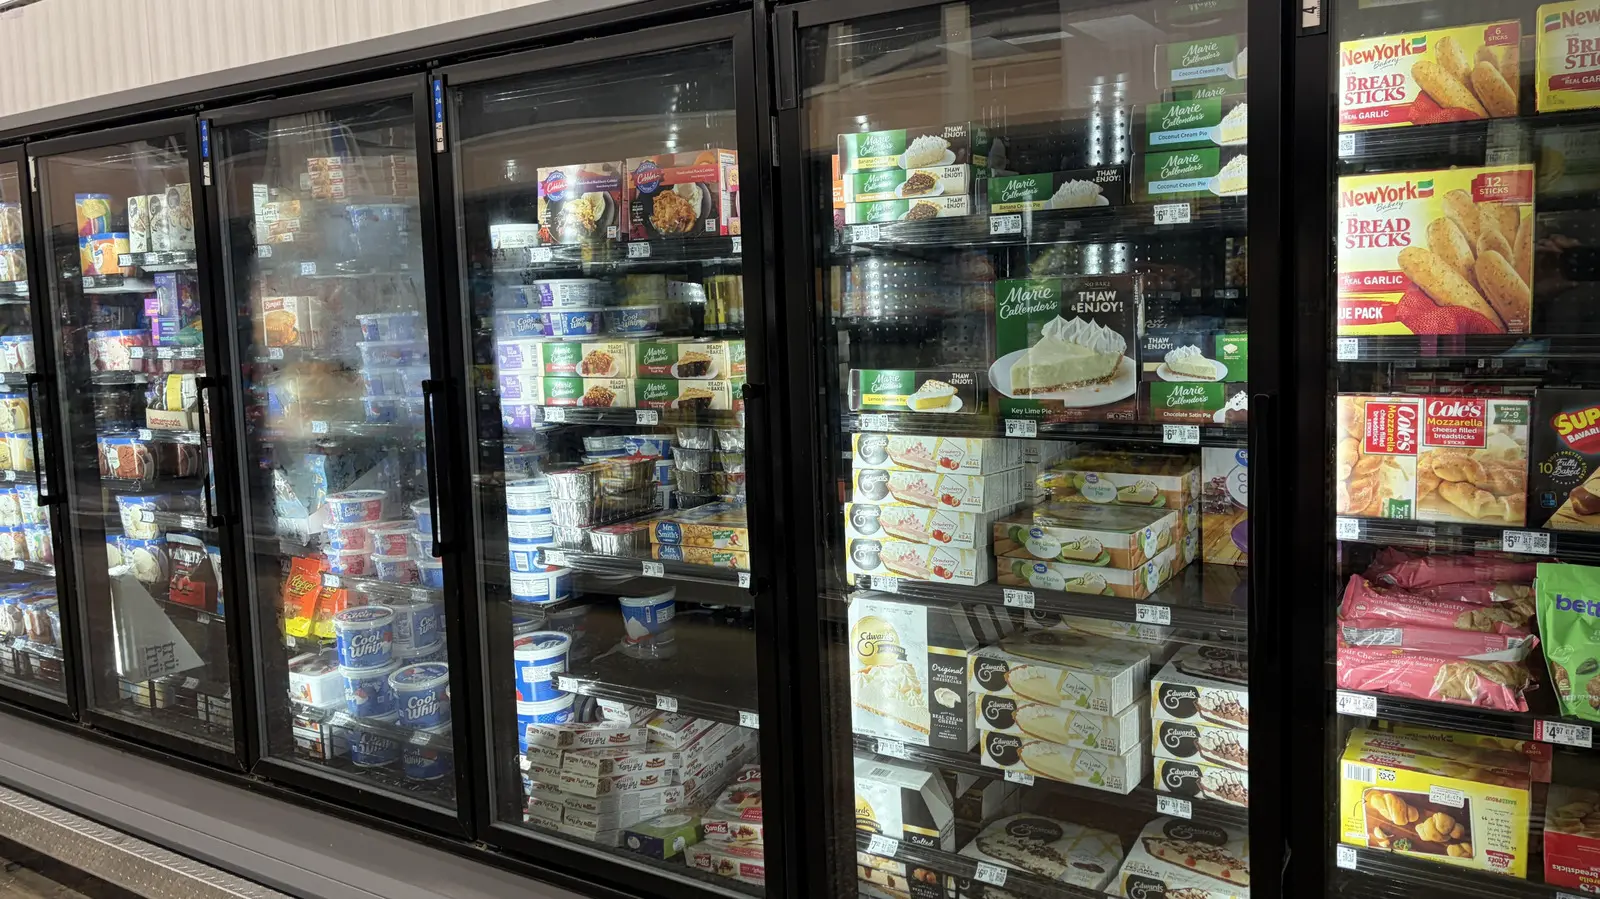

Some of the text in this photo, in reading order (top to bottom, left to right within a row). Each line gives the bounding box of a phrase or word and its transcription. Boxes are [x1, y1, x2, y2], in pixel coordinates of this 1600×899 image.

[1183, 42, 1218, 58] Marie
[1182, 52, 1220, 67] Callender's
[1346, 73, 1406, 92] BREAD
[1344, 86, 1406, 106] STICKS
[1162, 103, 1202, 120] Marie
[1359, 110, 1389, 119] GARLIC
[1162, 114, 1204, 130] Callender's
[1161, 154, 1200, 169] Marie
[1161, 163, 1203, 179] Callender's
[1002, 178, 1036, 193] Marie
[1486, 177, 1501, 187] 12
[1002, 187, 1039, 201] Callender's
[1479, 187, 1509, 195] STICKS
[1347, 218, 1410, 234] BREAD
[1345, 233, 1411, 249] STICKS
[1364, 275, 1403, 284] GARLIC
[1000, 287, 1054, 305] Marie
[1079, 291, 1117, 300] THAW
[1000, 301, 1058, 319] Callender's
[1354, 307, 1383, 319] PACK
[645, 348, 666, 356] Marie
[645, 383, 666, 392] Marie
[1167, 386, 1205, 398] Marie
[644, 391, 668, 400] Callender's
[1167, 396, 1208, 407] Callender's
[1428, 401, 1481, 417] Cole's
[1387, 404, 1396, 452] Mozzarella
[1398, 406, 1416, 451] Cole's
[1427, 418, 1483, 426] Mozzarella
[1538, 462, 1553, 474] 10
[1556, 458, 1578, 469] Fully
[1552, 466, 1581, 477] Baked
[658, 531, 678, 539] Smith's
[1440, 602, 1464, 611] Pastry
[420, 615, 435, 626] Cool
[351, 633, 379, 650] Cool
[350, 642, 383, 658] Whip
[932, 664, 964, 675] Original
[978, 663, 1006, 682] Edwards
[408, 692, 436, 709] Cool
[1163, 689, 1196, 708] Edwards
[406, 703, 440, 720] Whip
[986, 701, 1013, 720] Edwards
[1165, 729, 1196, 748] Edwards
[990, 738, 1020, 756] Edwards
[1167, 768, 1198, 788] Edwards
[704, 824, 727, 834] Sara Lee
[912, 836, 934, 846] Salted
[1552, 864, 1598, 878] breadsticks
[1131, 882, 1164, 899] Edwards
